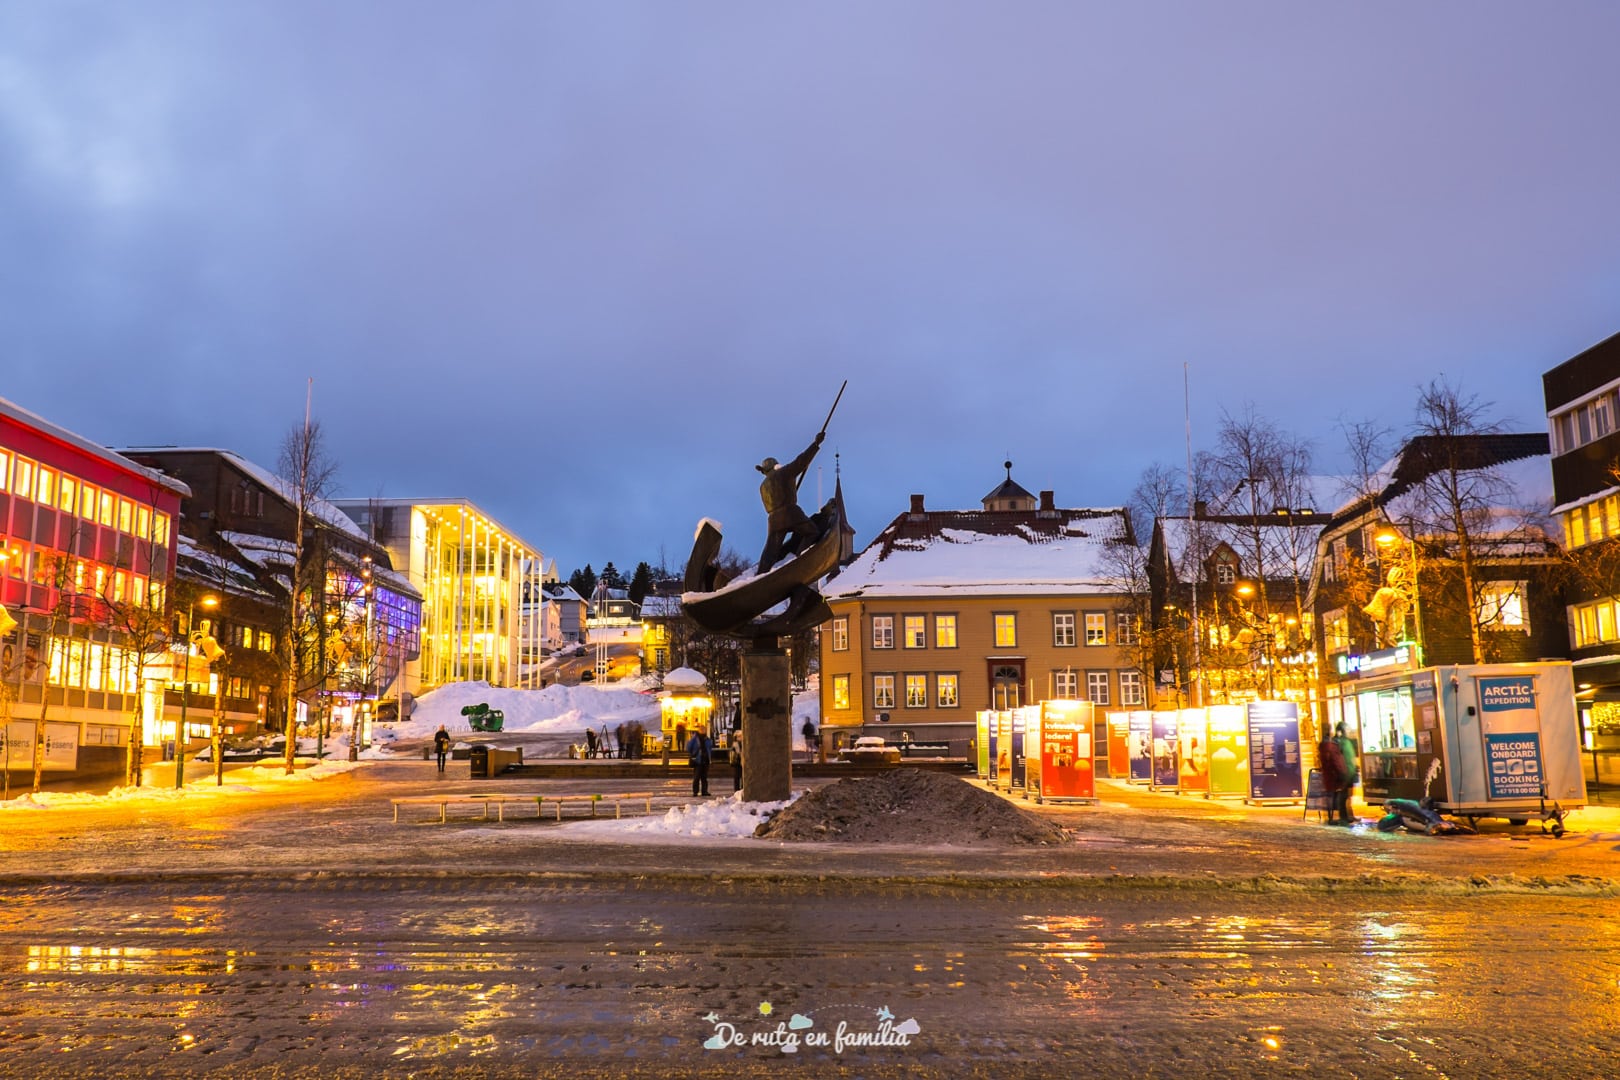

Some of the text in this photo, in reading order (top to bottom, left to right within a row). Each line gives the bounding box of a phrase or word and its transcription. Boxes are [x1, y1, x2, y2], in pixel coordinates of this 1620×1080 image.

[1484, 697, 1531, 705] EXPEDITION
[1490, 742, 1535, 750] WELCOME
[1491, 750, 1537, 759] ONBOARD!
[1493, 775, 1540, 784] BOOKING
